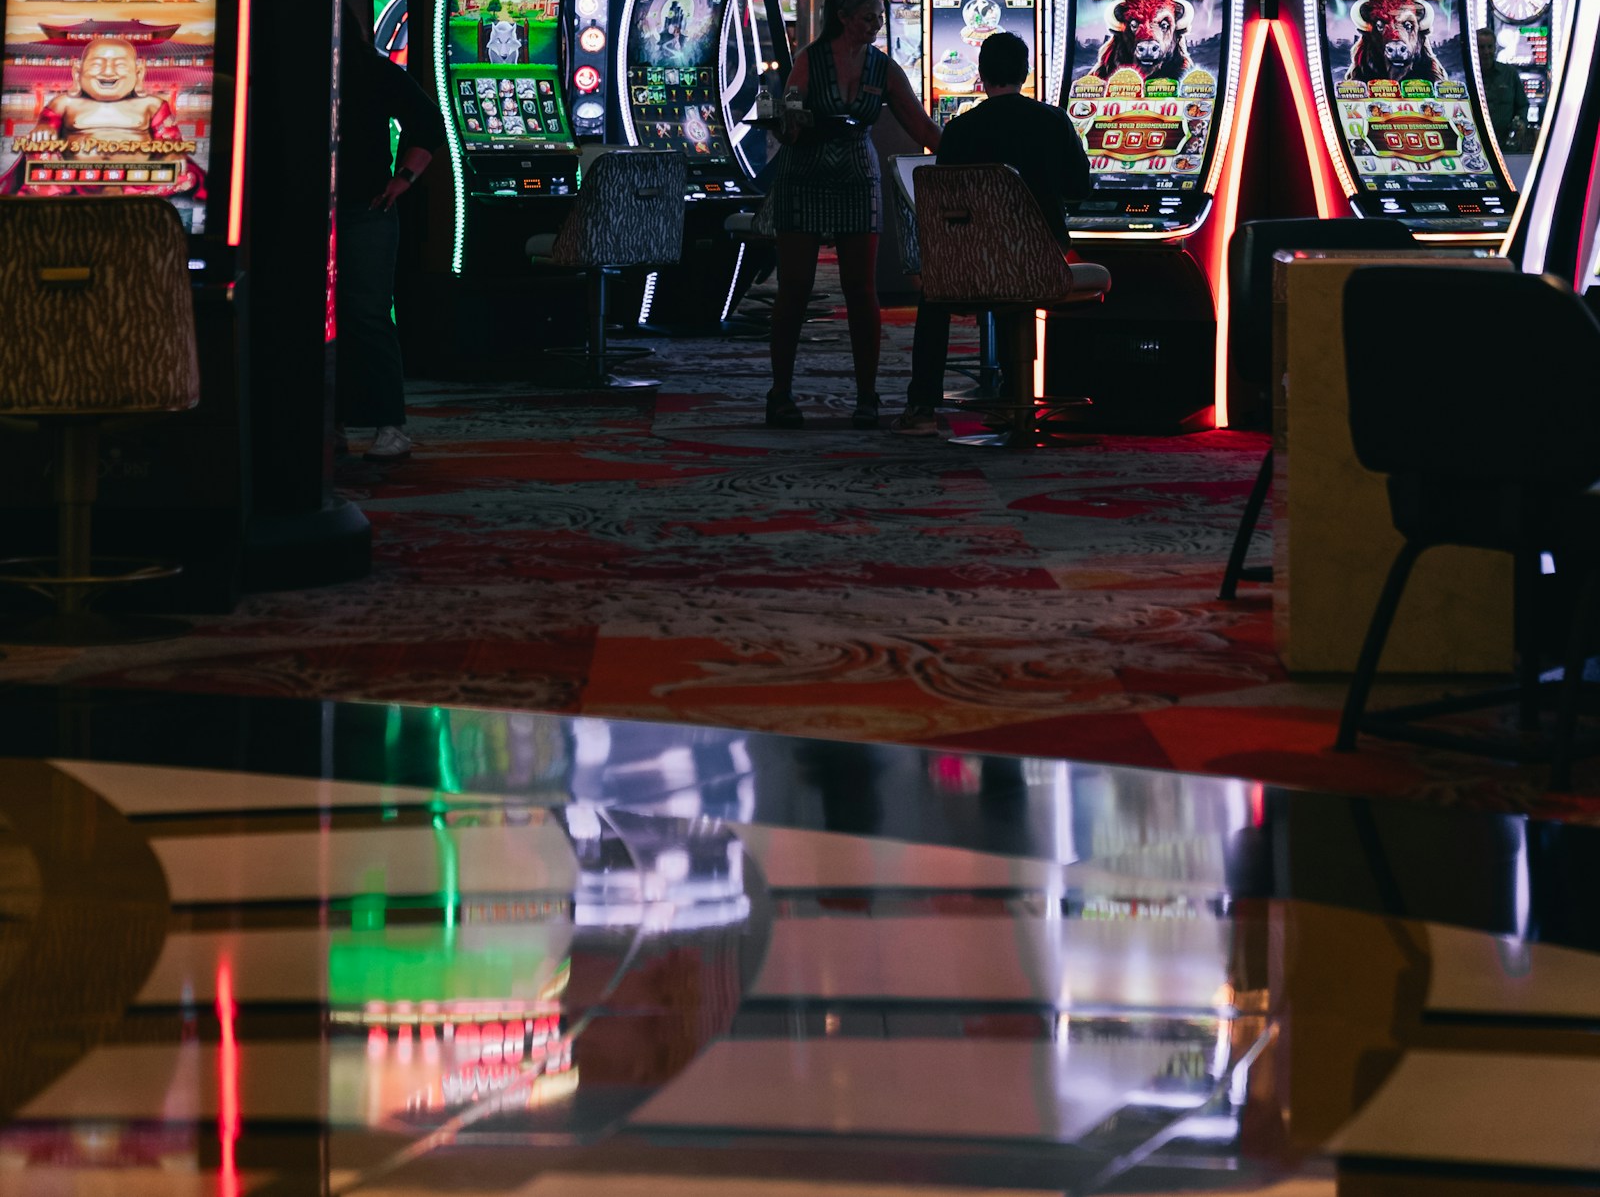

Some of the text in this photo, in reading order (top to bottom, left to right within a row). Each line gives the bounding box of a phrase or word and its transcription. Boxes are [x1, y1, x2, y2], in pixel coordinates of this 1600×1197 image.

[1103, 102, 1120, 116] 10
[1160, 102, 1177, 116] 10
[83, 137, 198, 153] PROSPEROUS
